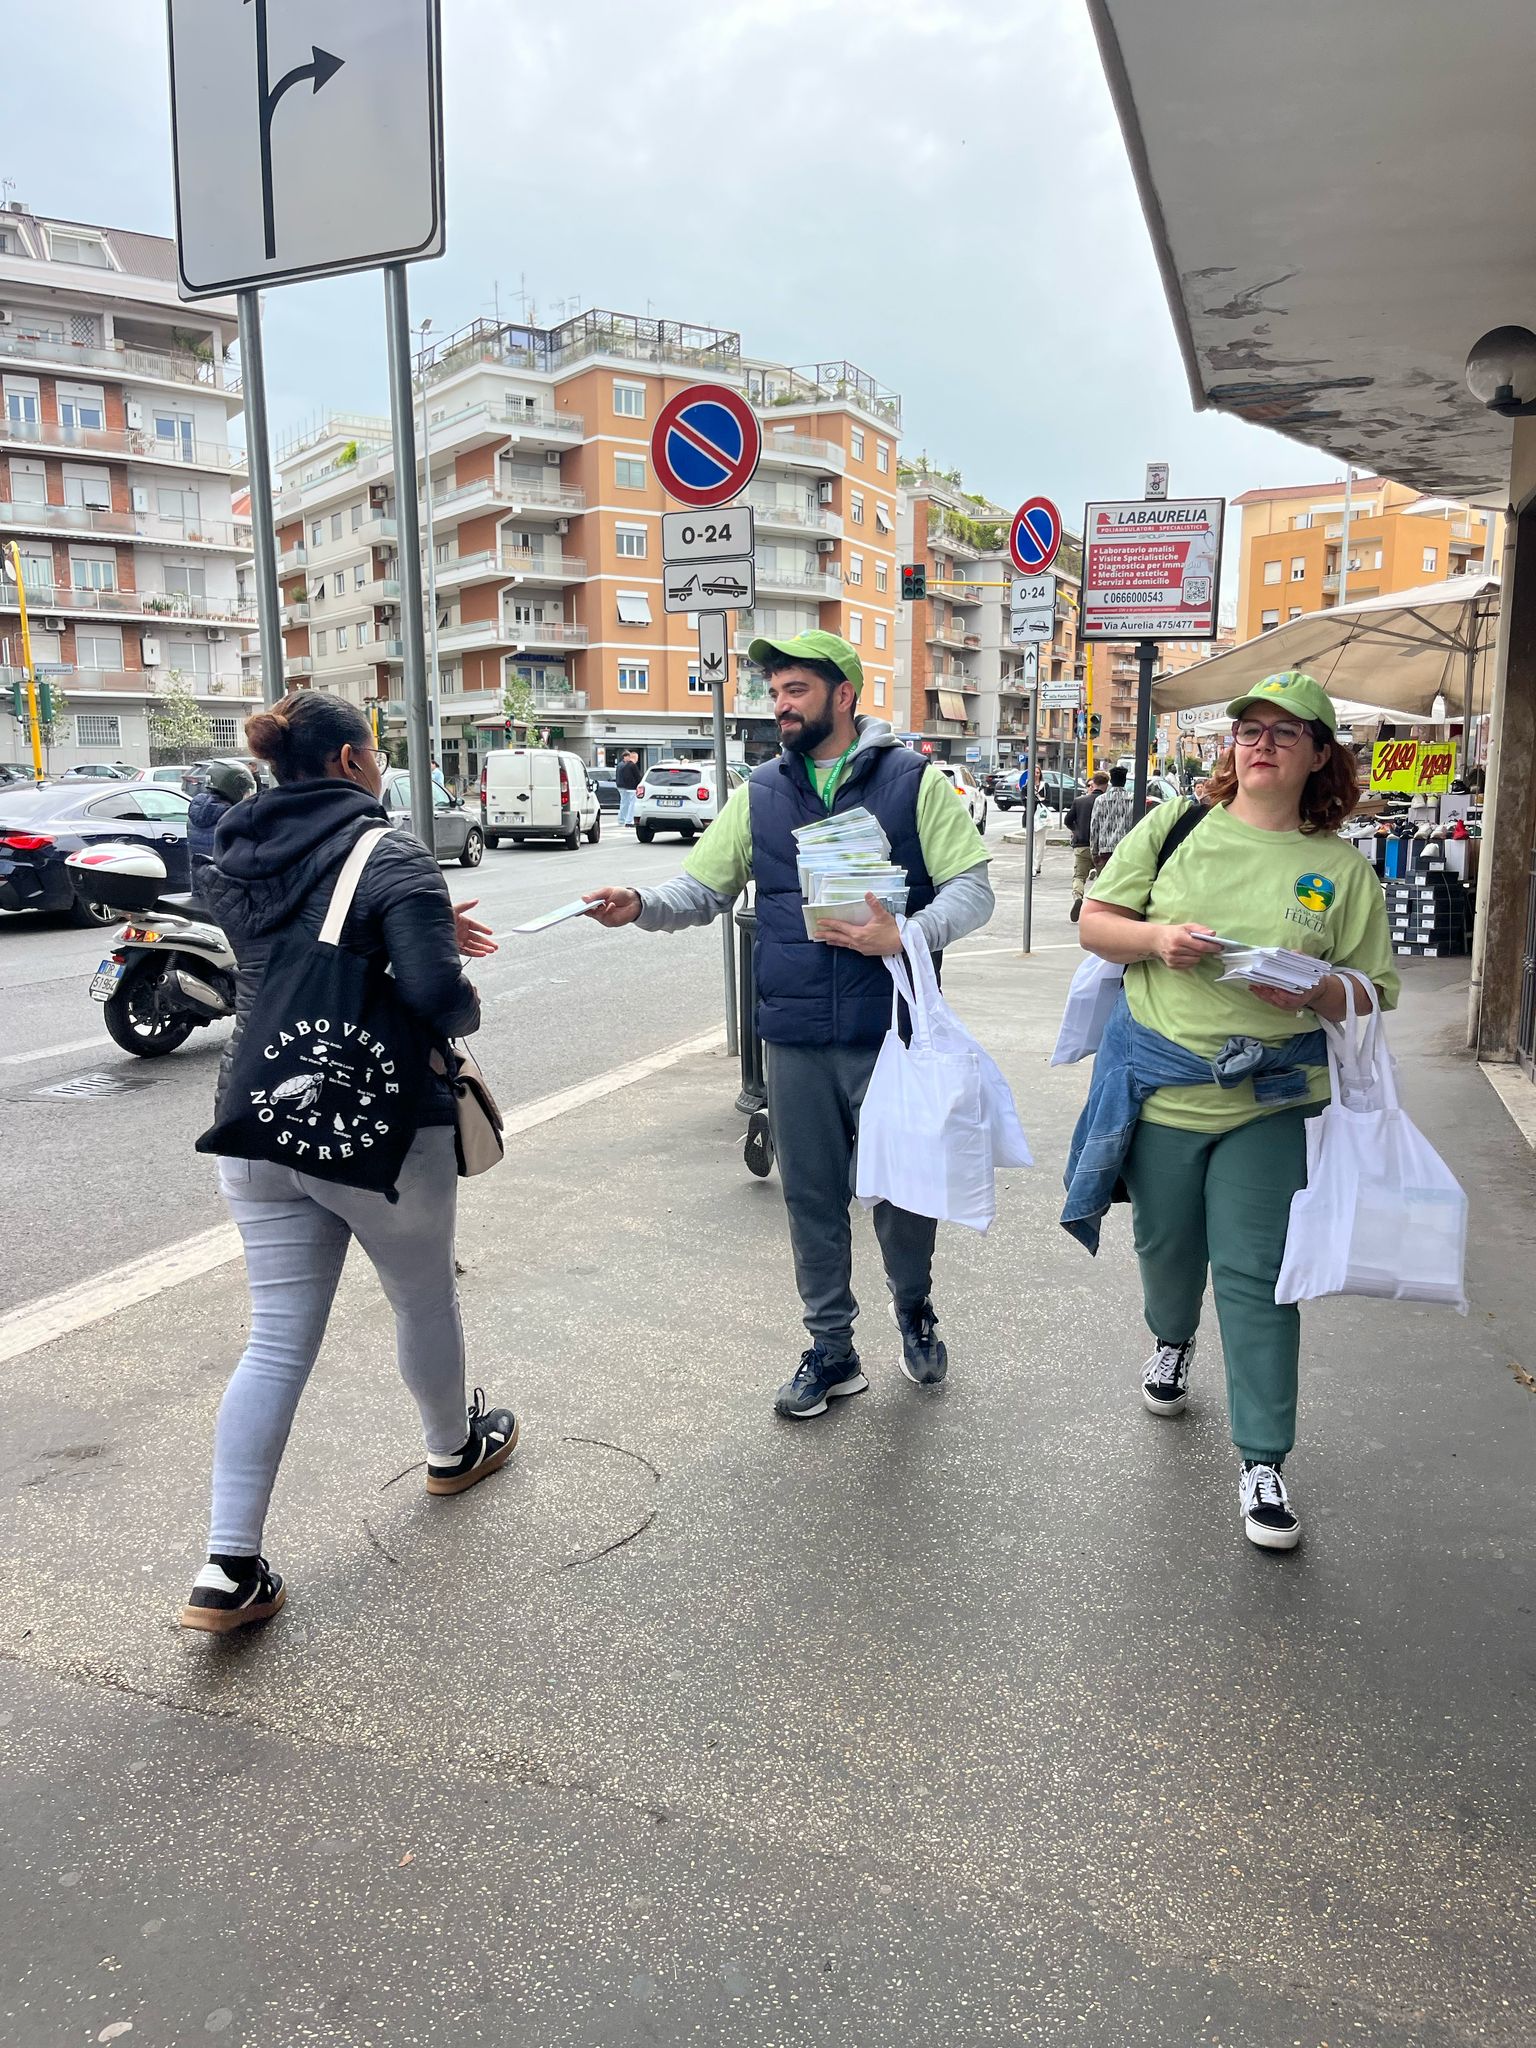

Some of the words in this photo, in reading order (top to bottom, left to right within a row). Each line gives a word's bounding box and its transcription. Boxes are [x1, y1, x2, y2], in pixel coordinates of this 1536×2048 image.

[1118, 509, 1208, 524] LABAURELIA
[682, 524, 732, 545] 0-24
[1124, 553, 1179, 562] Specialistiche
[1099, 562, 1145, 571] Diagnostica
[1020, 586, 1045, 600] 0-24
[1110, 592, 1163, 603] 0666000543
[1120, 621, 1154, 629] Aurelia
[1156, 620, 1192, 629] 475/477
[1285, 908, 1324, 932] FELICIT
[264, 1019, 330, 1059] CABO
[343, 1022, 399, 1094] VERDE
[250, 1090, 274, 1122] NO
[277, 1120, 389, 1160] STRESS
